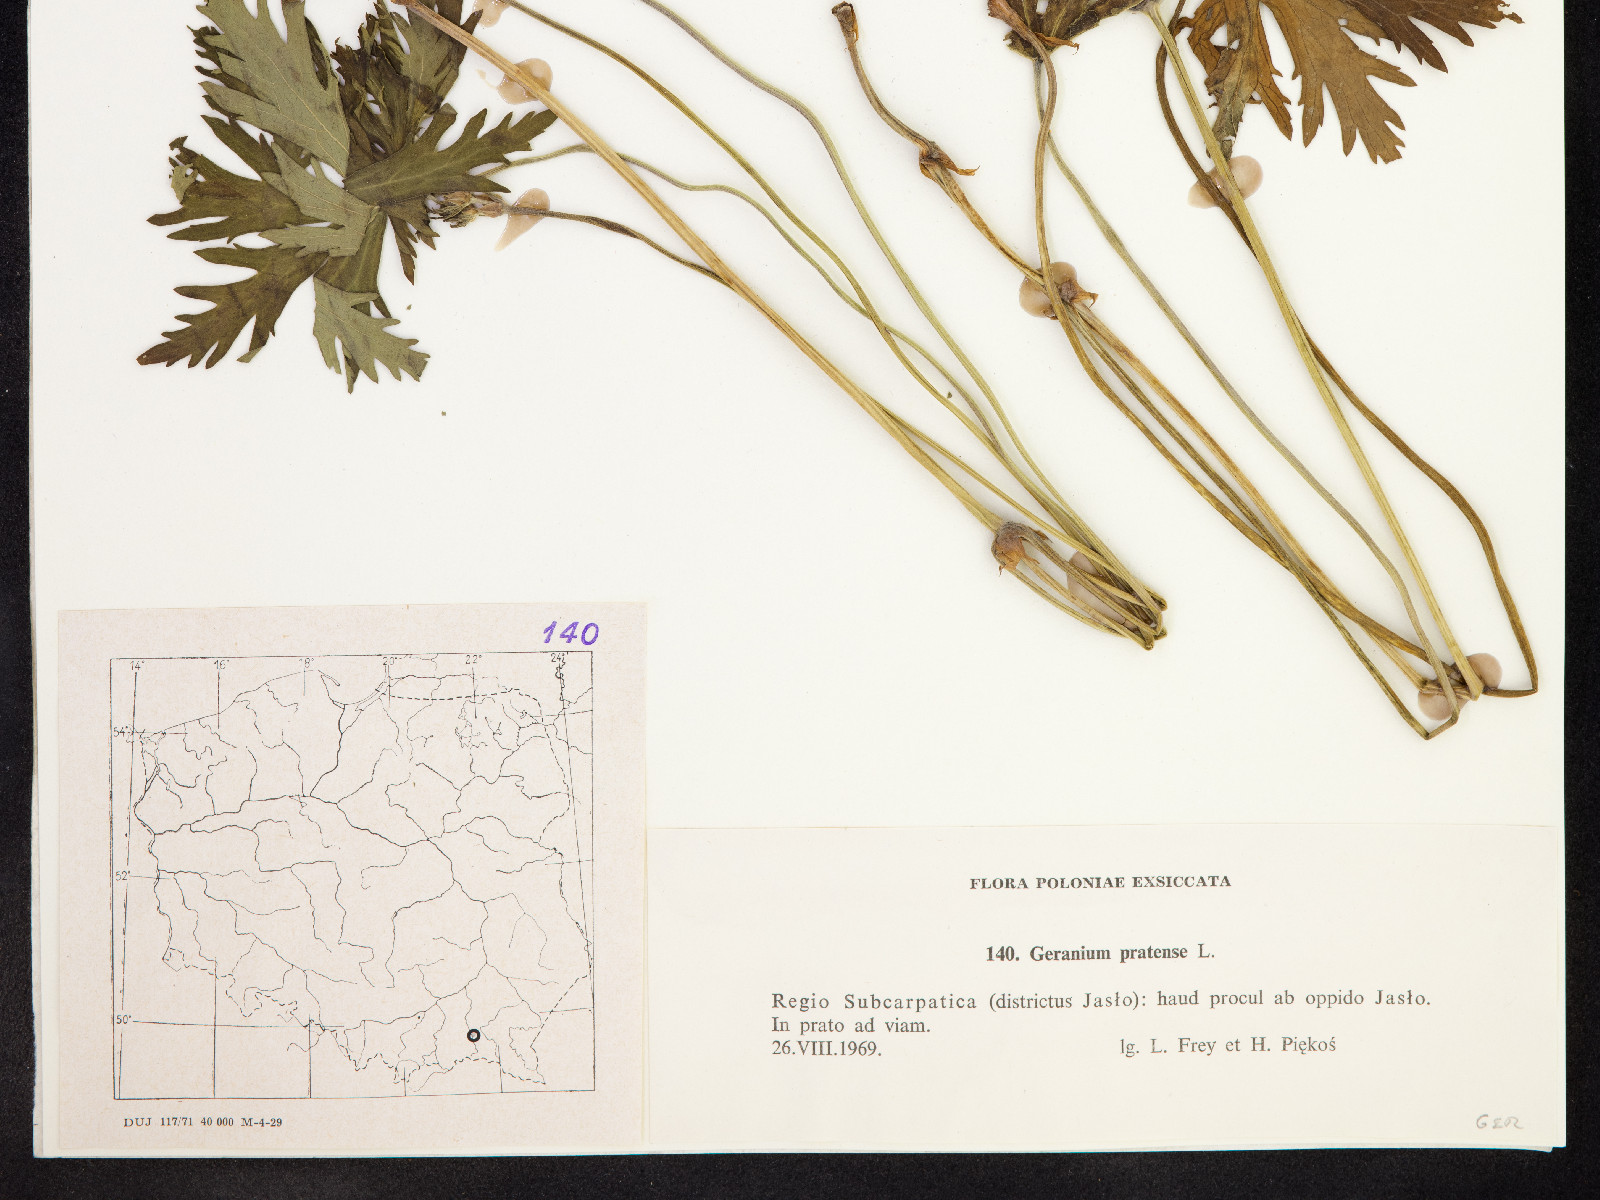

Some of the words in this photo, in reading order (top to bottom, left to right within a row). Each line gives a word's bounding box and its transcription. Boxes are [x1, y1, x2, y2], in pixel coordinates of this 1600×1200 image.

[543, 620, 600, 646] 140
[969, 877, 1029, 890] FLORA
[1035, 876, 1125, 889] POLONIAE
[1131, 875, 1232, 888] EXSICCATA
[986, 945, 1020, 962] 140.
[1029, 945, 1112, 962] Geranium
[1119, 945, 1188, 964] pratense
[1197, 943, 1215, 959] L.
[771, 993, 830, 1012] Regio
[844, 993, 977, 1012] Subcarpatica
[989, 992, 1073, 1012] (districtus
[1082, 991, 1146, 1010] Jasło):
[1156, 990, 1200, 1006] haud
[1209, 989, 1264, 1009] procul
[1274, 989, 1295, 1005] ab
[1305, 989, 1365, 1009] oppido
[1374, 989, 1431, 1006] Jasło.
[771, 1016, 791, 1033] In
[799, 1018, 845, 1036] prato
[854, 1017, 876, 1033] ad
[884, 1017, 931, 1033] viam.
[771, 1039, 882, 1057] 26.VIII.1969.
[1120, 1038, 1140, 1058] lg.
[1150, 1038, 1167, 1054] L.
[1177, 1037, 1217, 1056] Frey
[1225, 1039, 1241, 1052] et
[1250, 1036, 1271, 1052] H.
[1281, 1036, 1336, 1054] Piękoś
[123, 1117, 152, 1128] DUJ
[160, 1116, 192, 1127] 117/71
[240, 1117, 283, 1128] M-4-29
